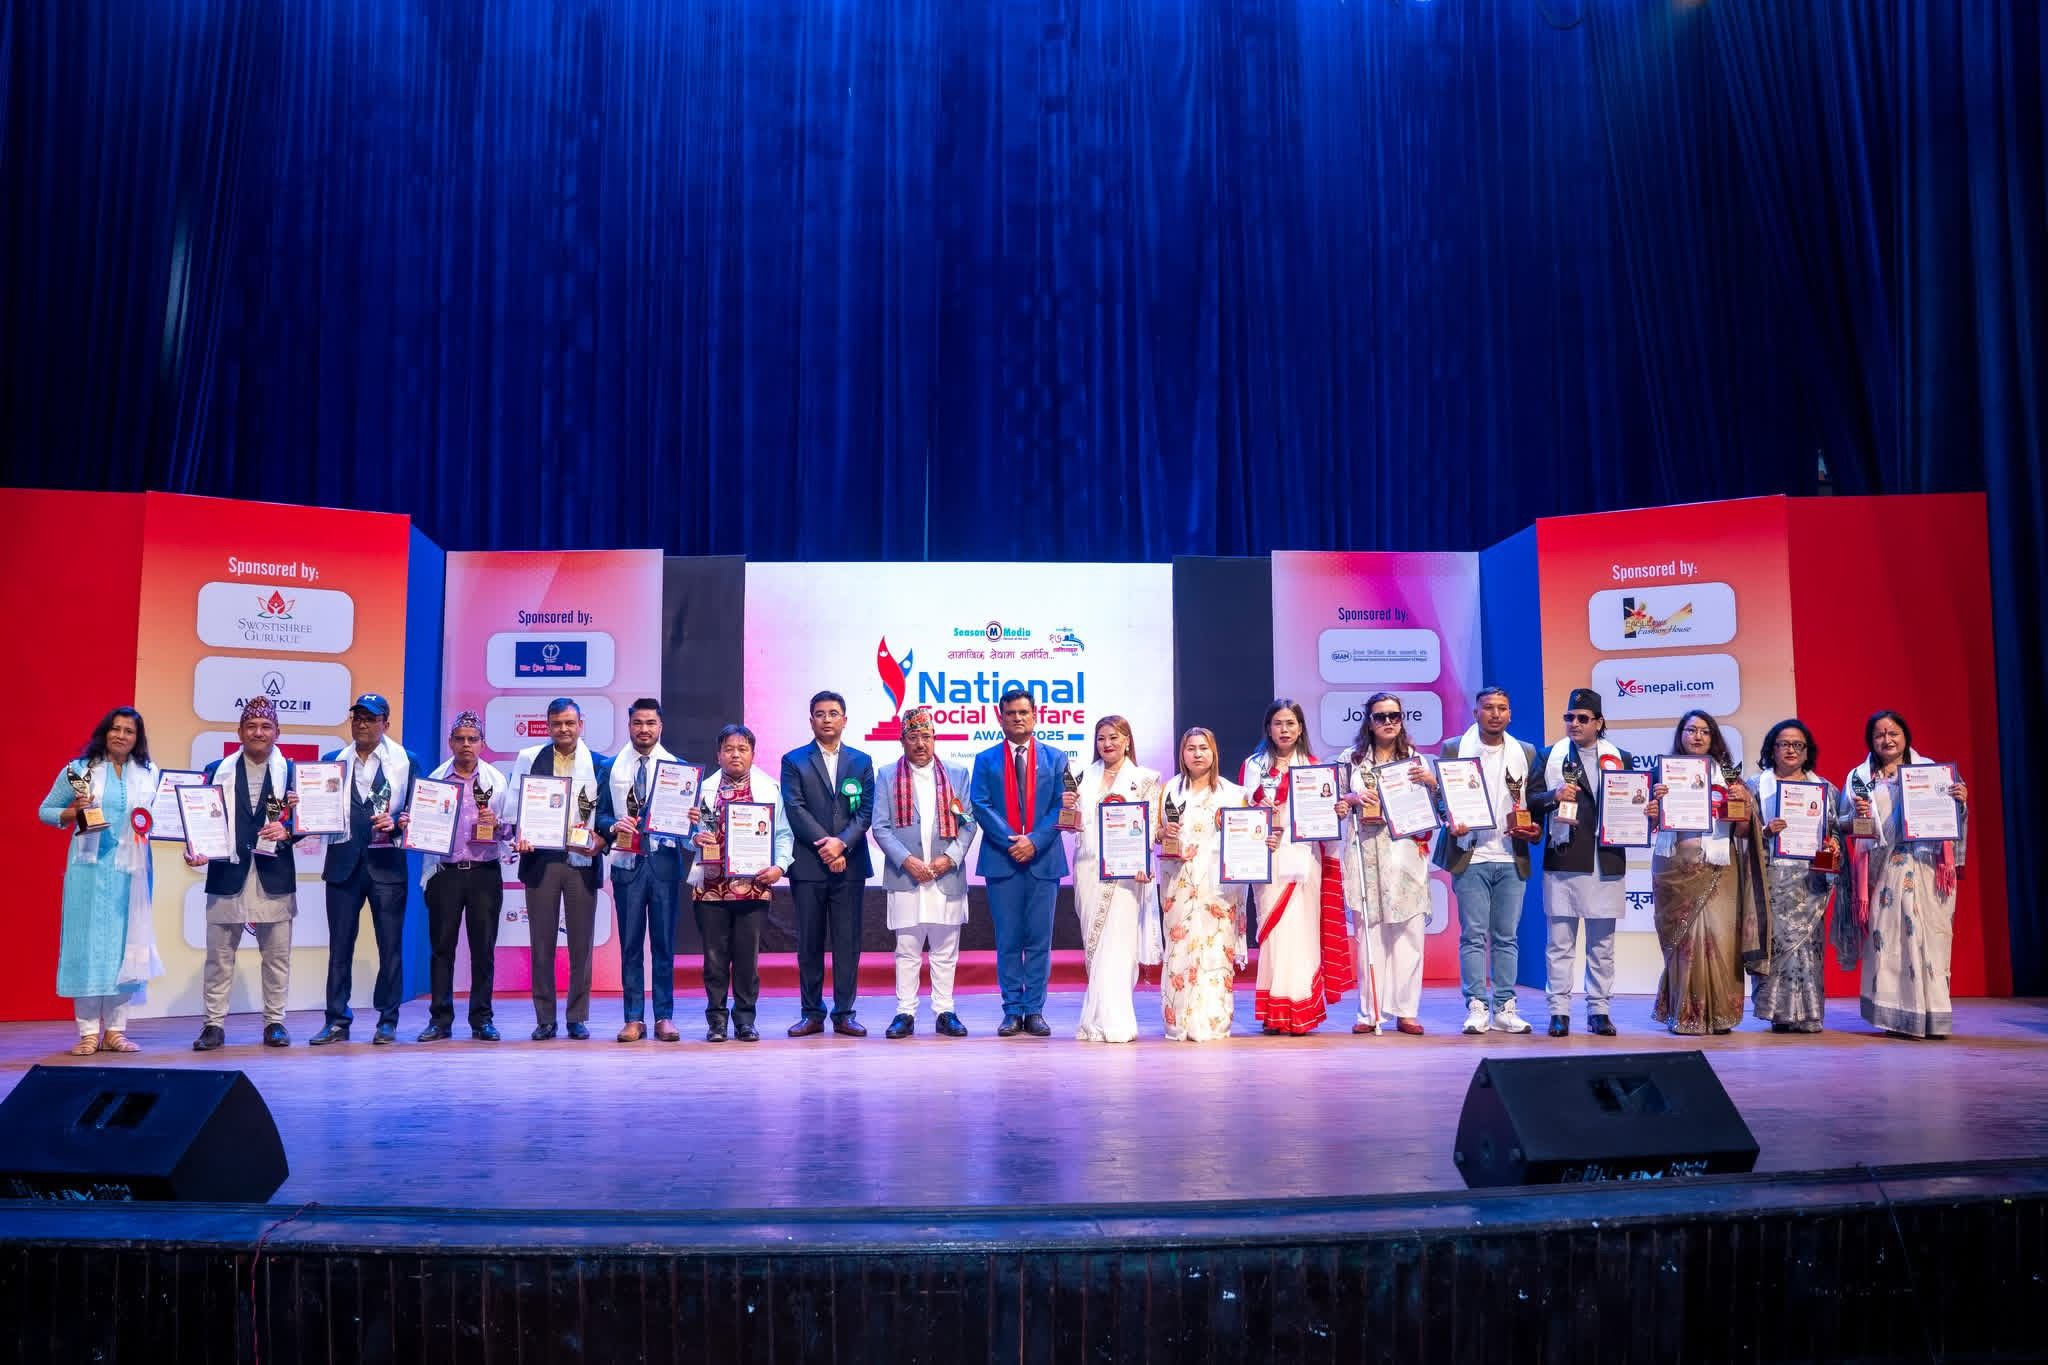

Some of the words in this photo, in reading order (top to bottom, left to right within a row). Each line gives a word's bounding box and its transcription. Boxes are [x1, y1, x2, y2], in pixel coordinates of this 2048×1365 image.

[228, 556, 296, 577] Sponsored
[301, 561, 320, 581] by:
[1612, 560, 1676, 582] Sponsored
[1680, 559, 1698, 578] by:
[518, 610, 574, 626] Sponsored
[578, 610, 593, 626] by:
[1338, 607, 1391, 622] Sponsored
[953, 627, 986, 637] Season
[1003, 627, 1031, 637] Media
